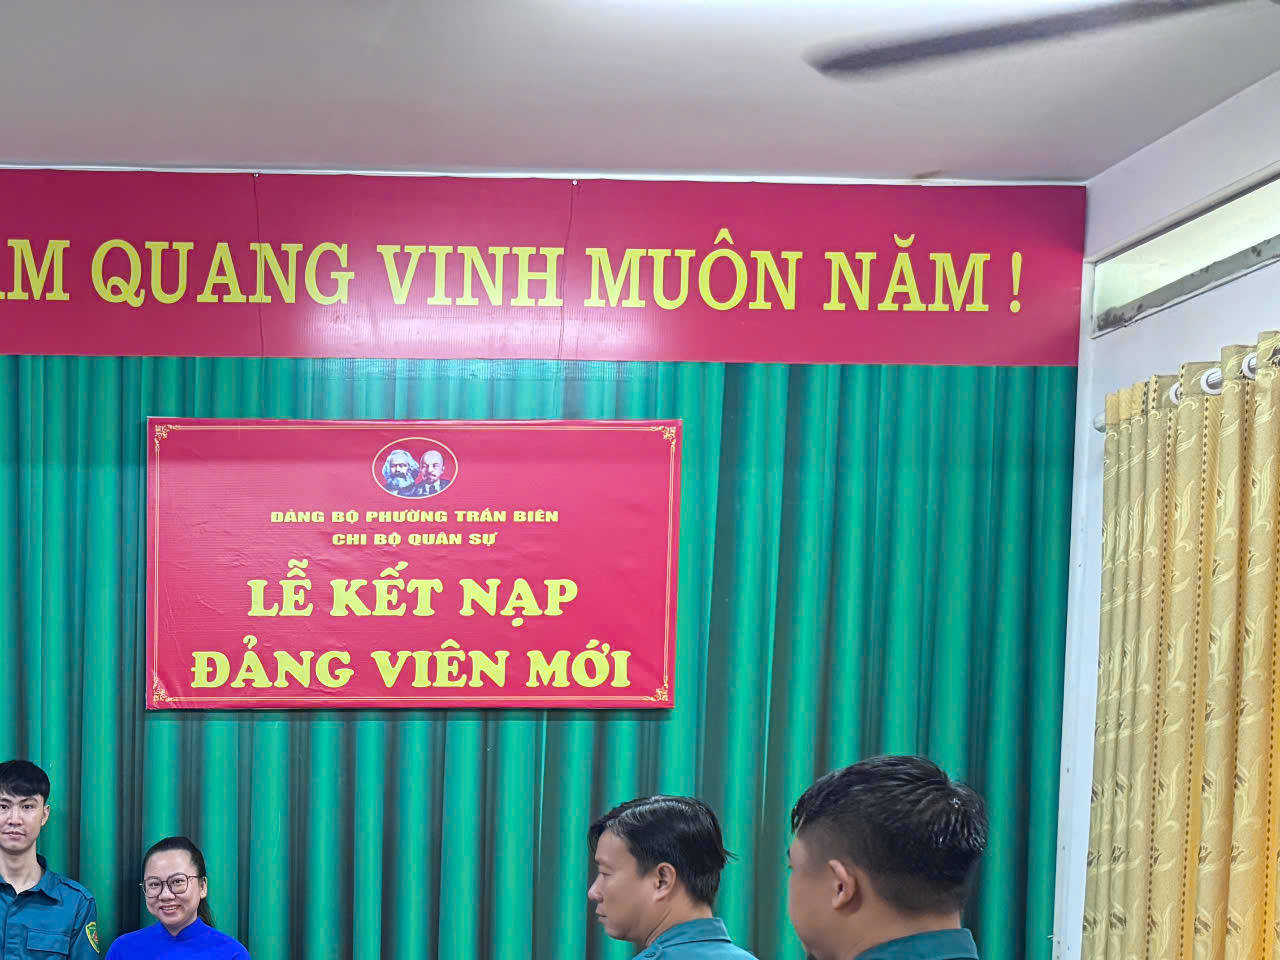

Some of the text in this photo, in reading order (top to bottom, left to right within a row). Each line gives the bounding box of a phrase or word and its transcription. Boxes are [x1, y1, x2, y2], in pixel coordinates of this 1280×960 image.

[92, 240, 354, 307] QUANG
[378, 246, 564, 304] VINH
[586, 229, 802, 310] MUÔN
[824, 237, 989, 311] NĂM
[1011, 253, 1021, 312] !
[271, 508, 558, 525] ĐẢNG BỘ PHƯỜNG TRẤN BIÊN
[332, 532, 498, 547] CHI BỘ QUÂN SỰ
[248, 560, 577, 626] LỄ KẾT NẠP
[192, 636, 630, 688] ĐẢNG VIÊN MỚI
